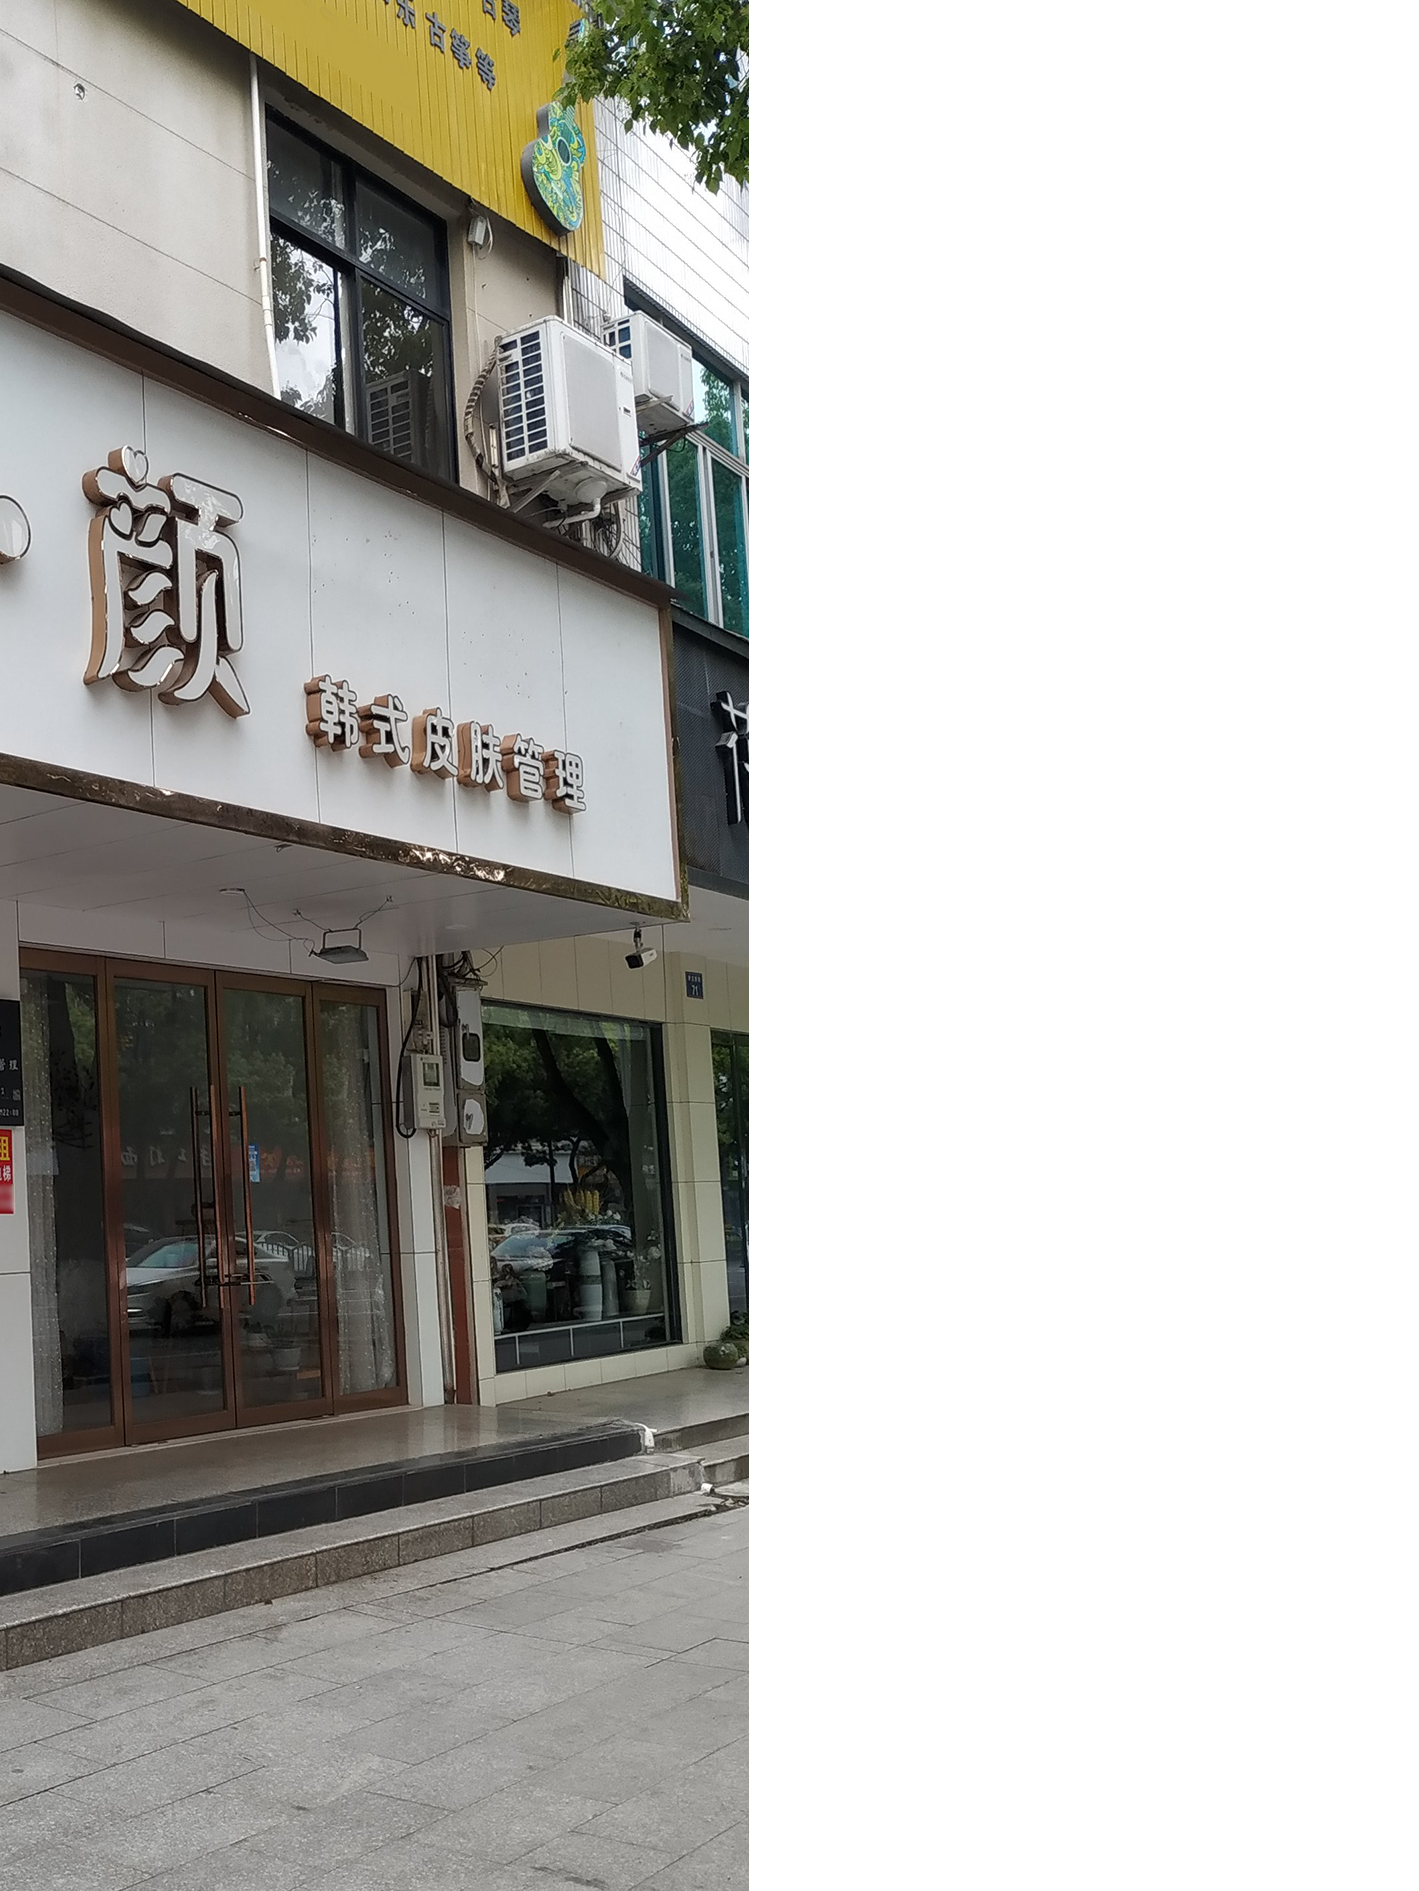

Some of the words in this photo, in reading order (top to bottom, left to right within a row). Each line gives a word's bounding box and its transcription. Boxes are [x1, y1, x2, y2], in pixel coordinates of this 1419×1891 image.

[385, 0, 496, 89] 乐古筝等
[305, 675, 587, 813] 韩式皮肤管理
